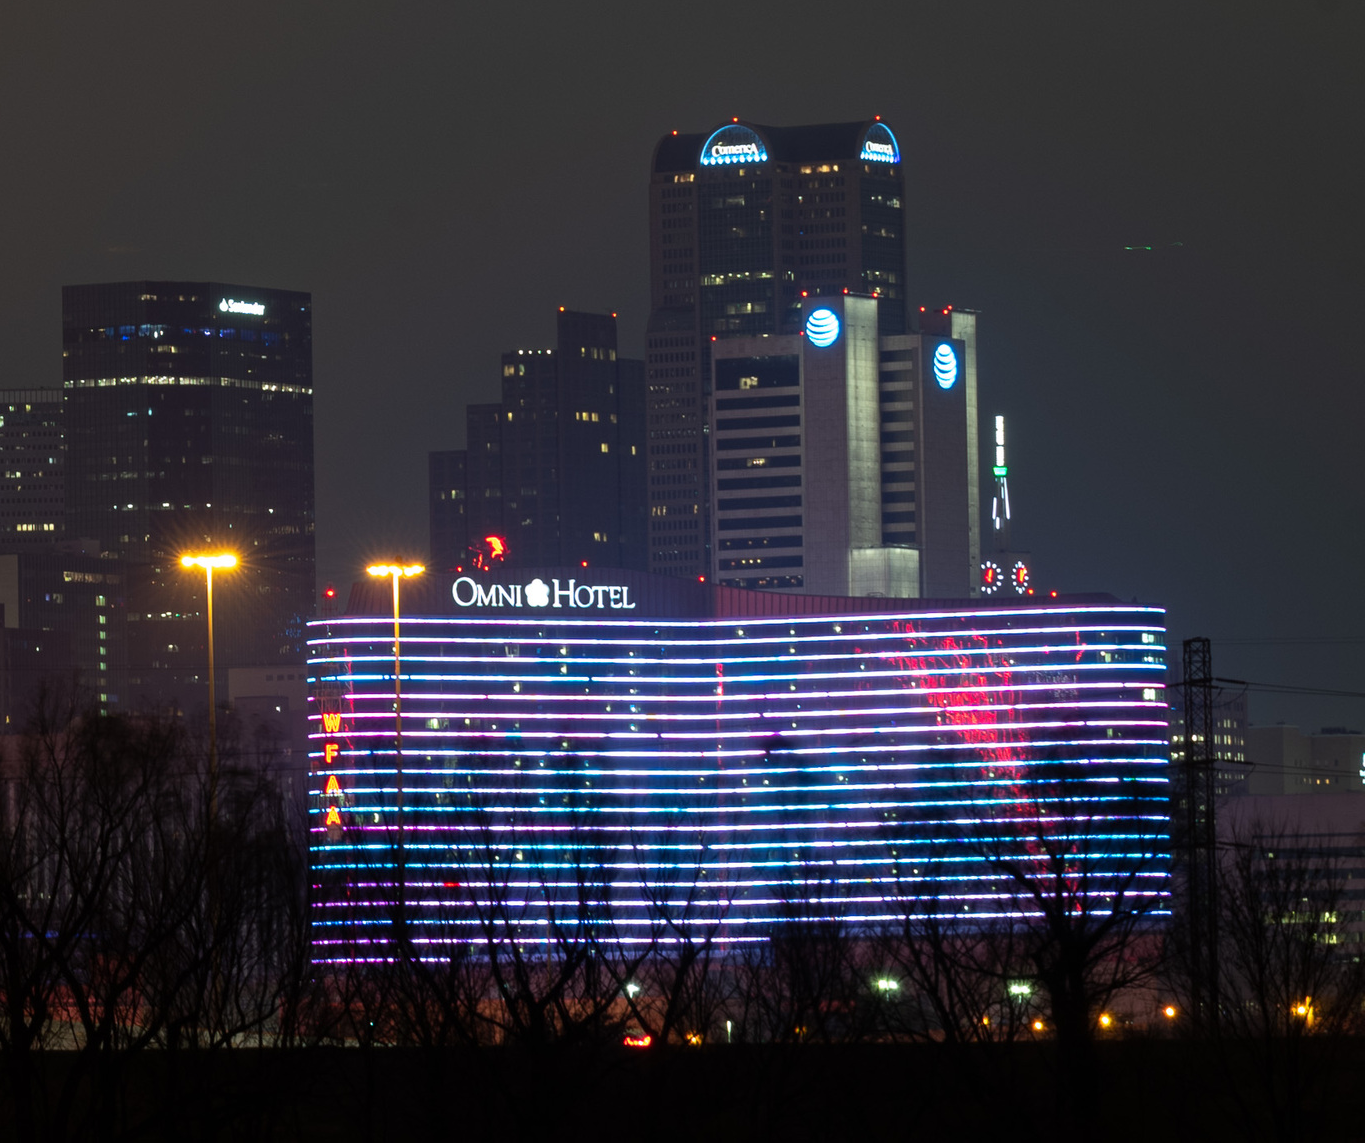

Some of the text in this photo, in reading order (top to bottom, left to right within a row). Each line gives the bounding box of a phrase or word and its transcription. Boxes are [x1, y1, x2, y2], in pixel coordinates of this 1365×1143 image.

[452, 577, 636, 608] OMNI HOTEL
[323, 713, 341, 825] WFAA
